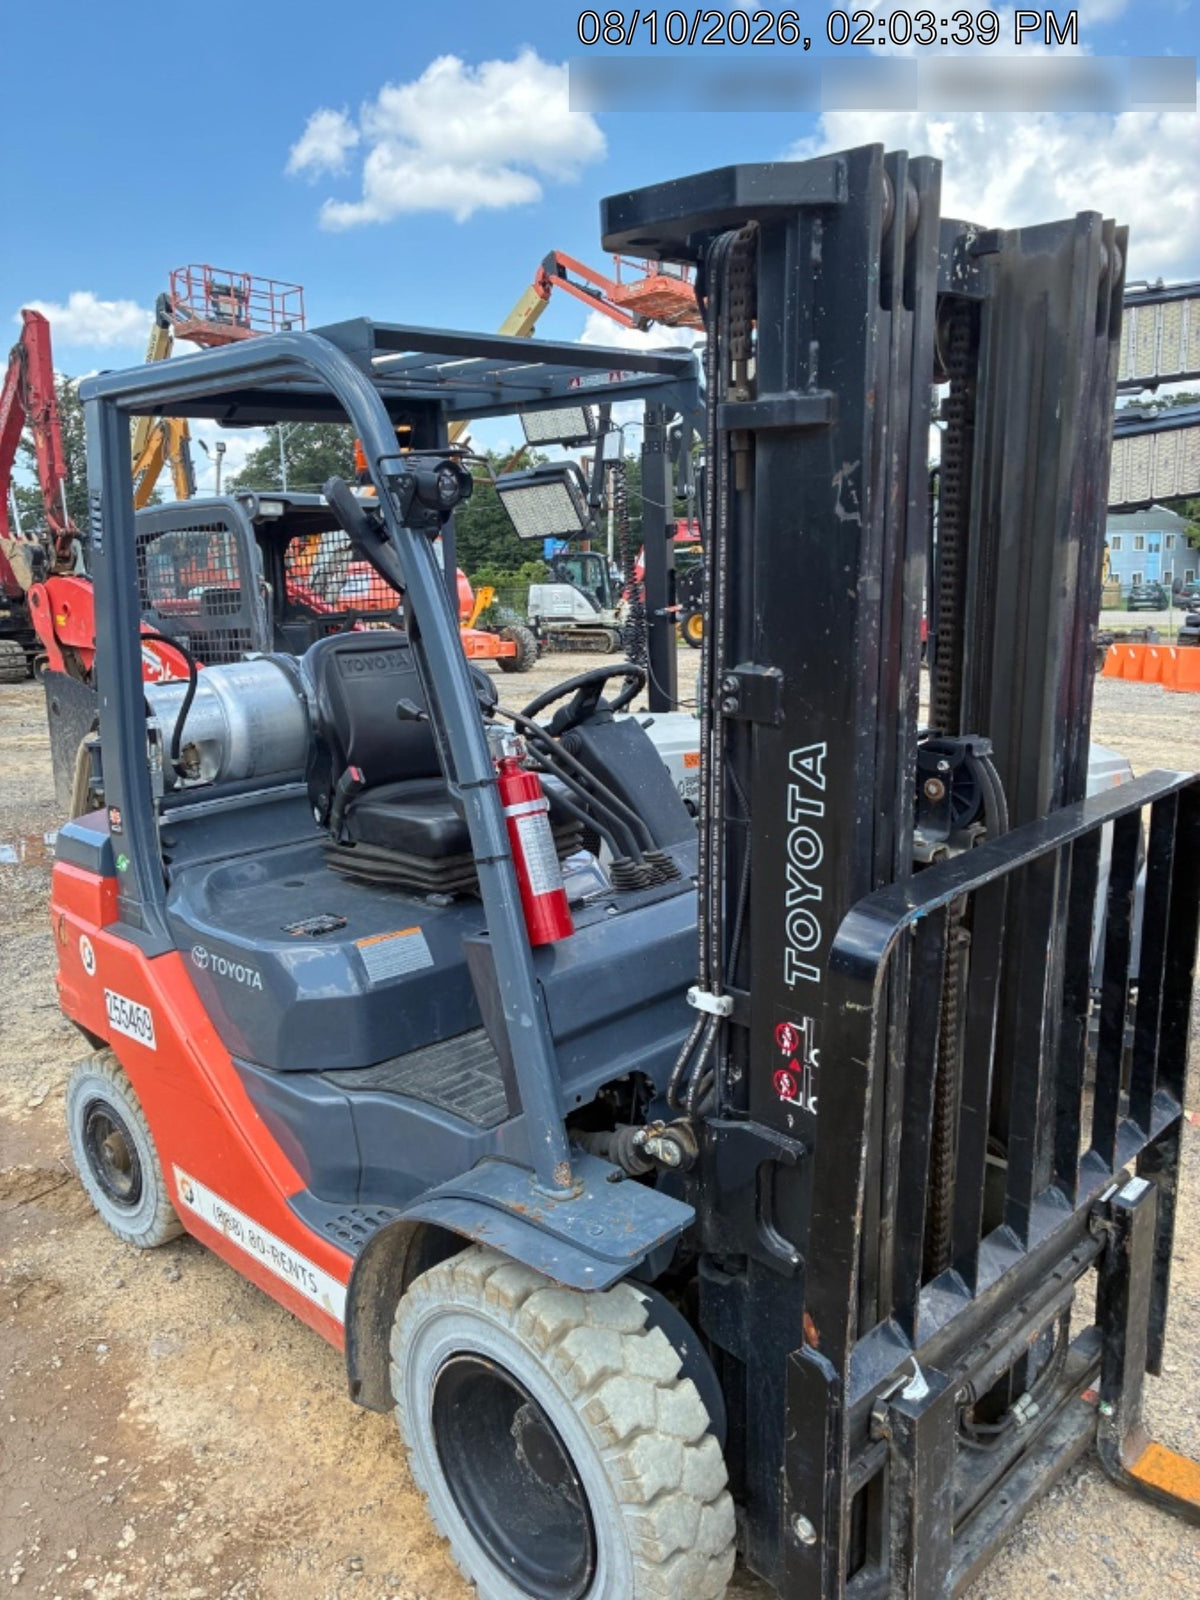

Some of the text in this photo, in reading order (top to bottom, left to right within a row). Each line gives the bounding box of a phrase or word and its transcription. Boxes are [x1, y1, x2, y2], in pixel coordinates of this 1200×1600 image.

[342, 653, 410, 672] TOYOTA
[784, 741, 827, 985] TOYOTA
[210, 954, 263, 991] TOYOTA
[248, 1230, 318, 1293] 80-RENTS
